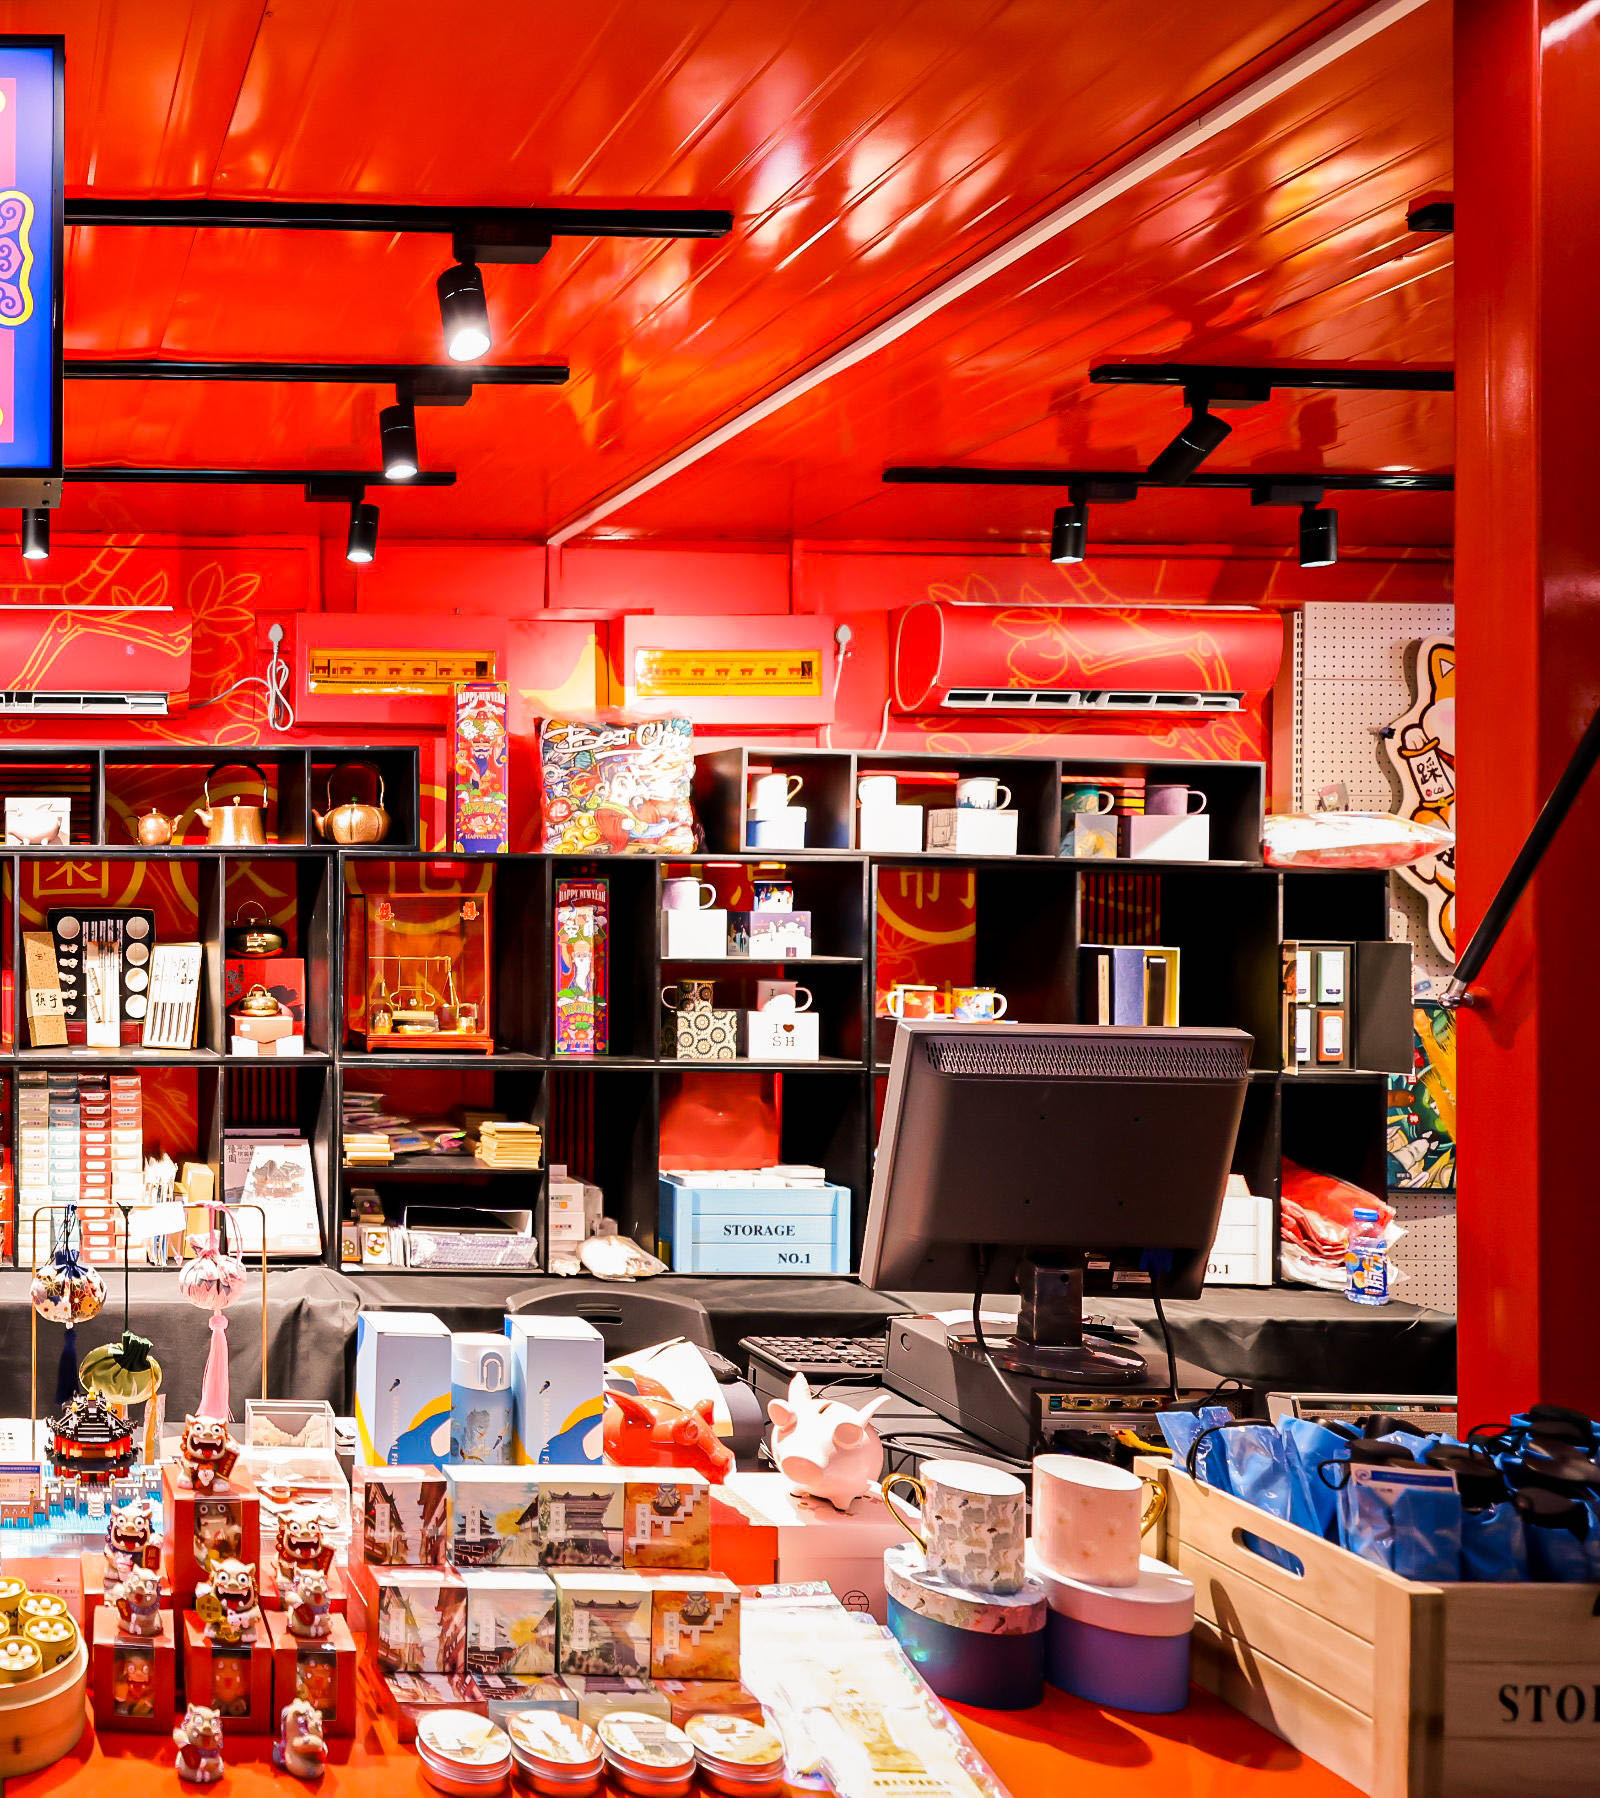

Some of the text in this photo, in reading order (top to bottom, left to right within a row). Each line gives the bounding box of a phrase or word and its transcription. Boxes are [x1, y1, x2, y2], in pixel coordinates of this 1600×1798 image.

[543, 725, 634, 753] Best
[559, 889, 578, 903] HAPPY
[774, 1023, 781, 1034] I
[722, 1222, 797, 1238] STORAGE
[777, 1251, 812, 1265] NO.1
[1207, 1263, 1229, 1274] O.1
